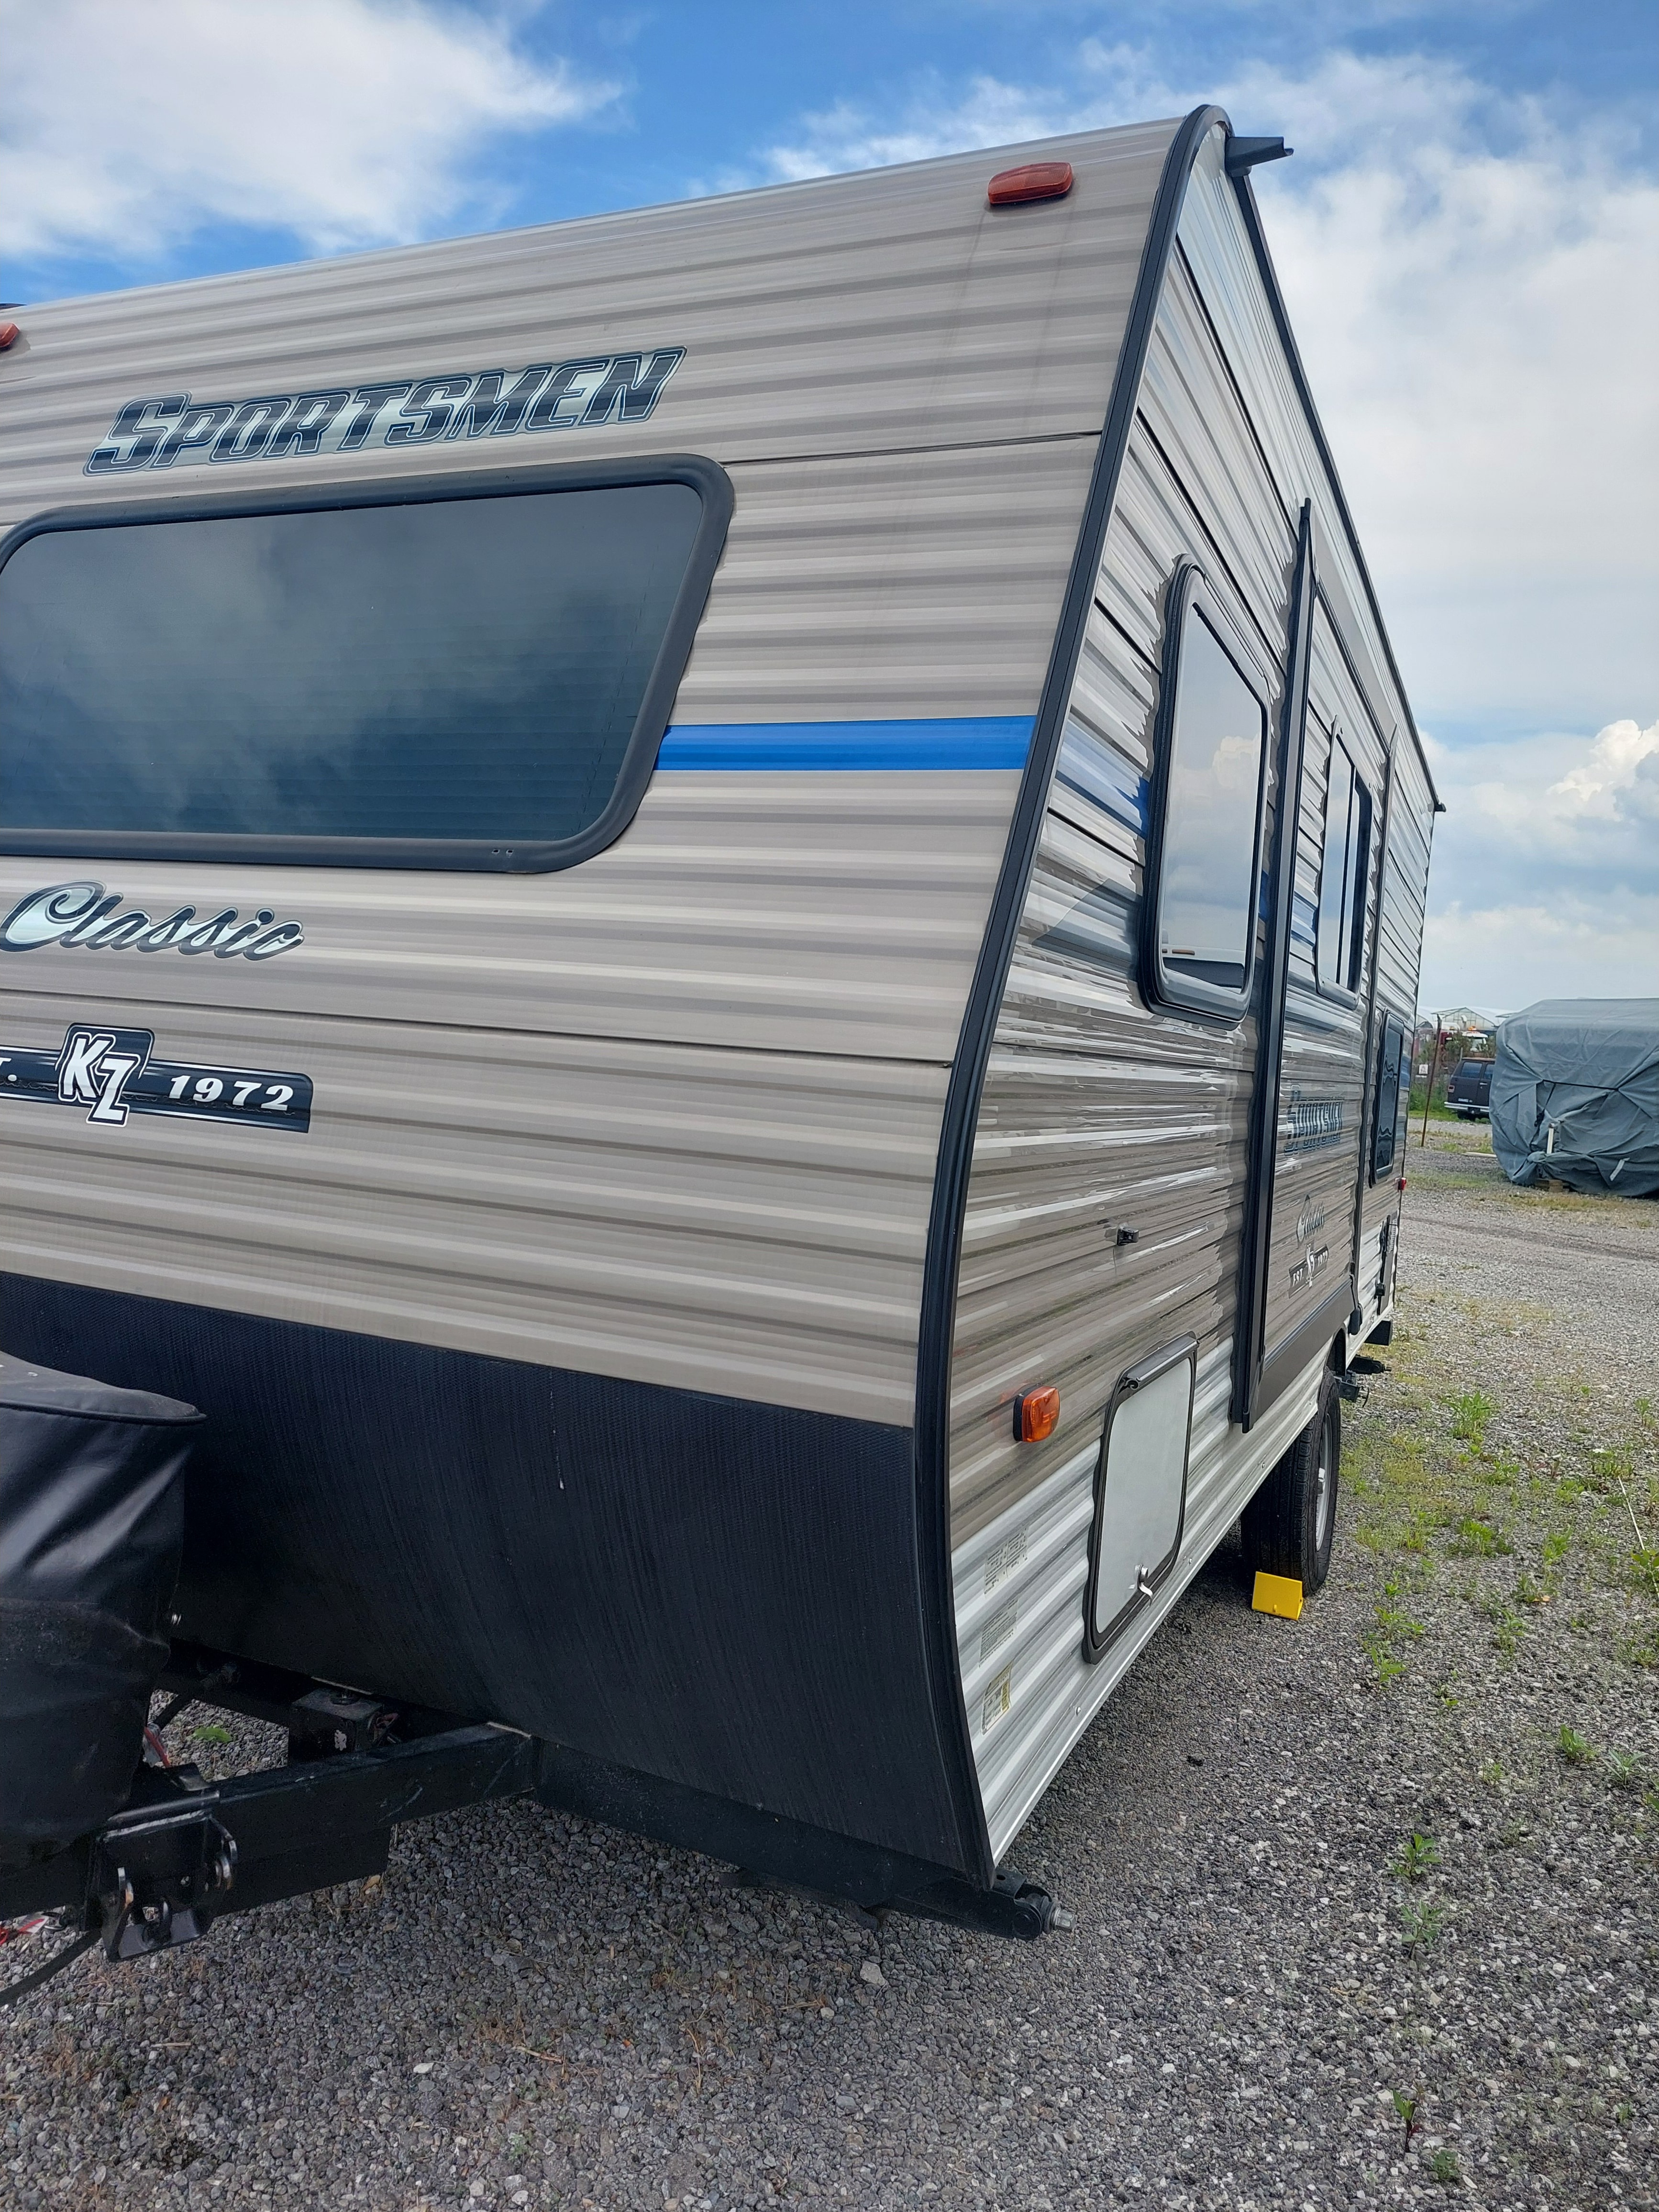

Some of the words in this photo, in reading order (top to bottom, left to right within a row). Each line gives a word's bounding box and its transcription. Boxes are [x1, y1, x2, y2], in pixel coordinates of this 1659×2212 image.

[84, 347, 687, 476] SPORTSMEN
[0, 881, 304, 960] Classic
[59, 1033, 139, 1127] KZ
[168, 1075, 293, 1111] 1972
